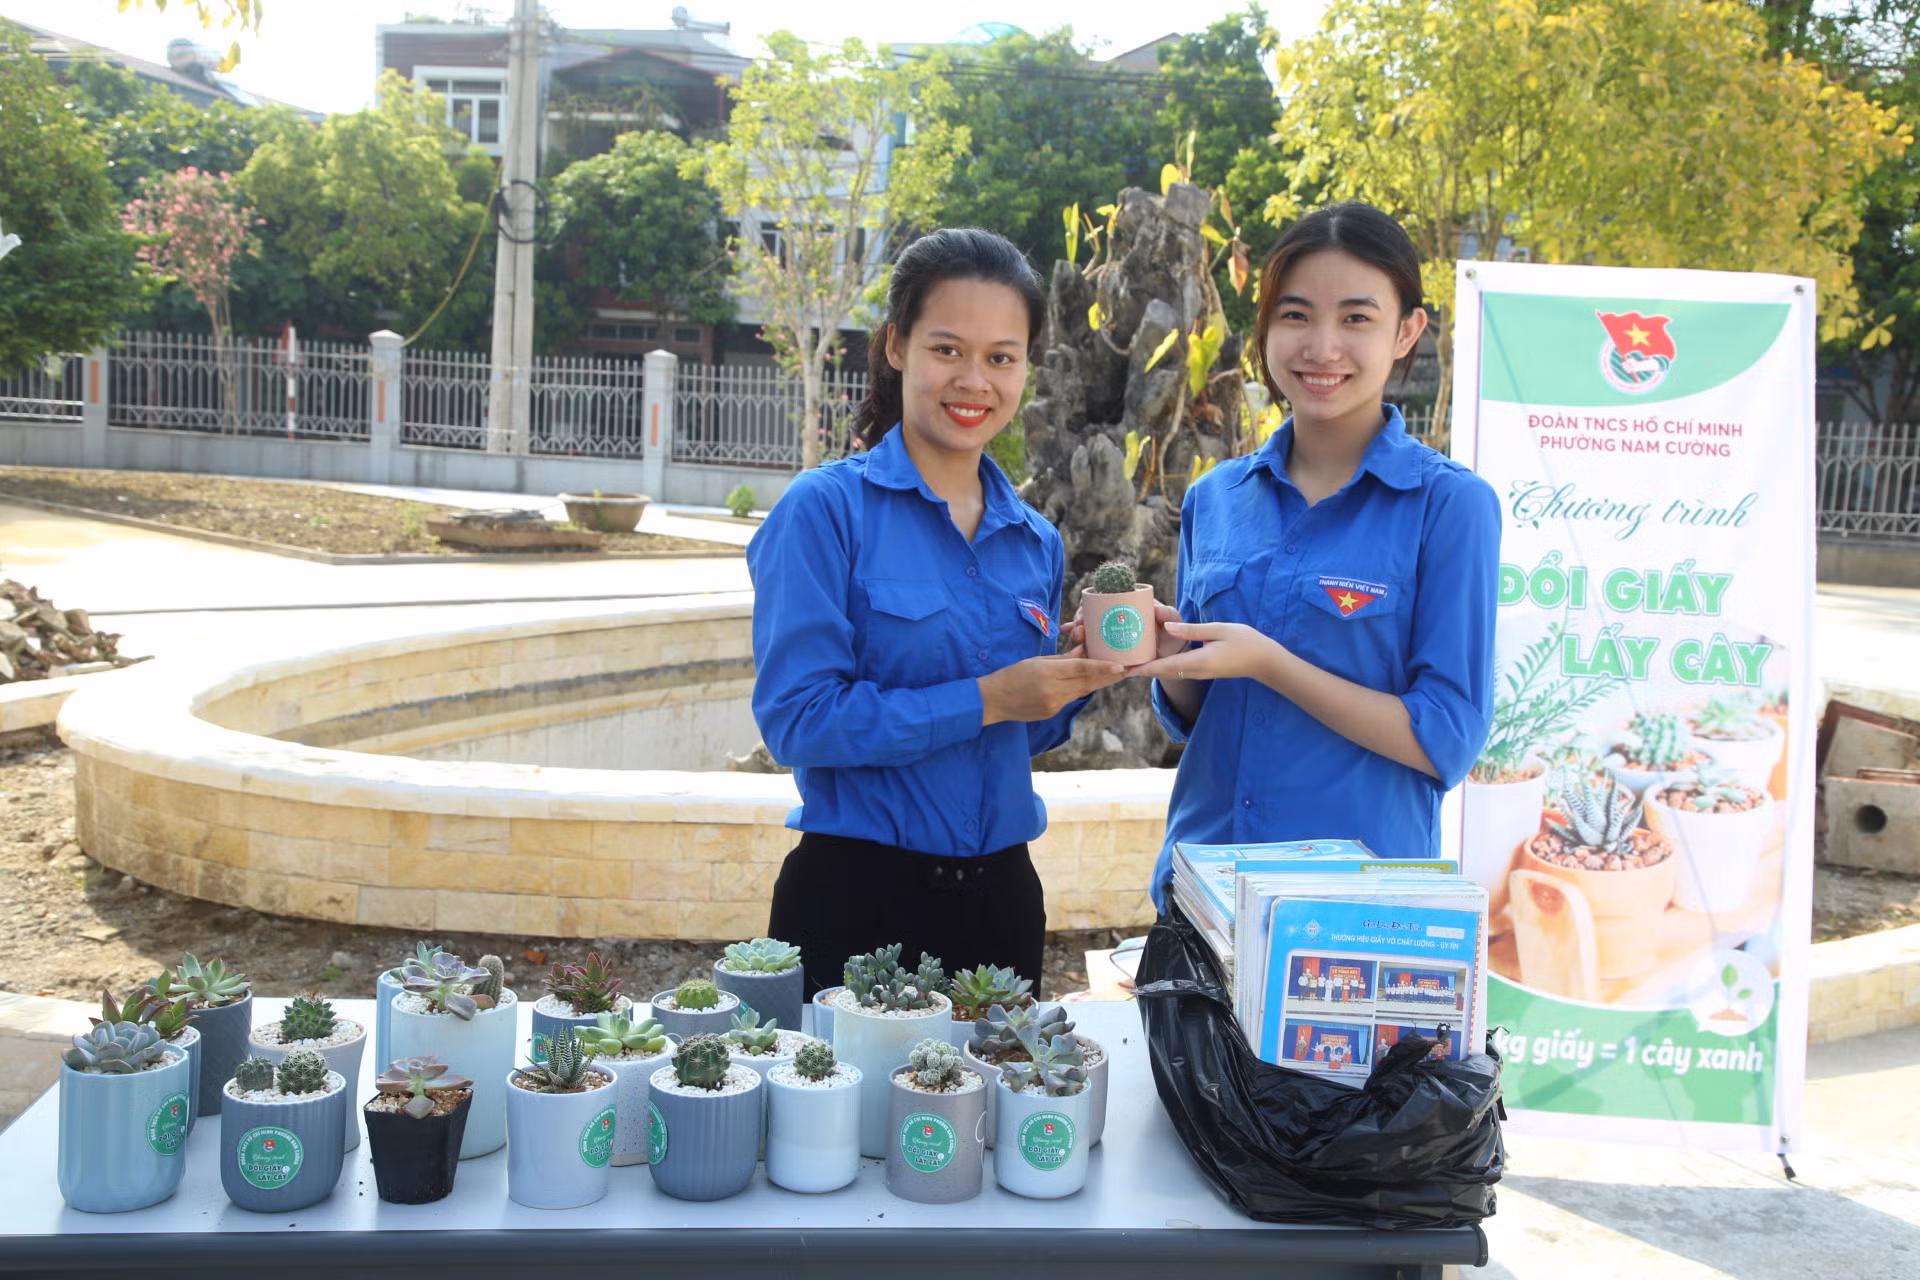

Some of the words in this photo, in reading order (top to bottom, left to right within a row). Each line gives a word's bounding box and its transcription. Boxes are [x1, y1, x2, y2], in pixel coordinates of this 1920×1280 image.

[1528, 412, 1578, 429] ĐOÀN
[1584, 417, 1628, 431] TNCS
[1633, 416, 1658, 433] HỒ
[1664, 418, 1694, 435] CHÍ
[1698, 423, 1743, 437] MINH
[1540, 434, 1616, 452] PHƯỜNG
[1621, 440, 1660, 453] NAM
[1665, 441, 1731, 457] CƯỜNG
[1509, 480, 1652, 541] Chương
[1662, 492, 1759, 528] trình
[1370, 586, 1385, 595] NAM
[1498, 550, 1587, 610] ĐỔI
[1603, 559, 1733, 616] GIẤY
[1560, 623, 1661, 681] LẤY
[1670, 633, 1774, 687] CÂY
[1532, 1028, 1595, 1069] giấy
[1600, 1043, 1617, 1059] =
[1624, 1036, 1636, 1063] 1
[1640, 1038, 1692, 1075] cây
[1696, 1042, 1763, 1072] xanh
